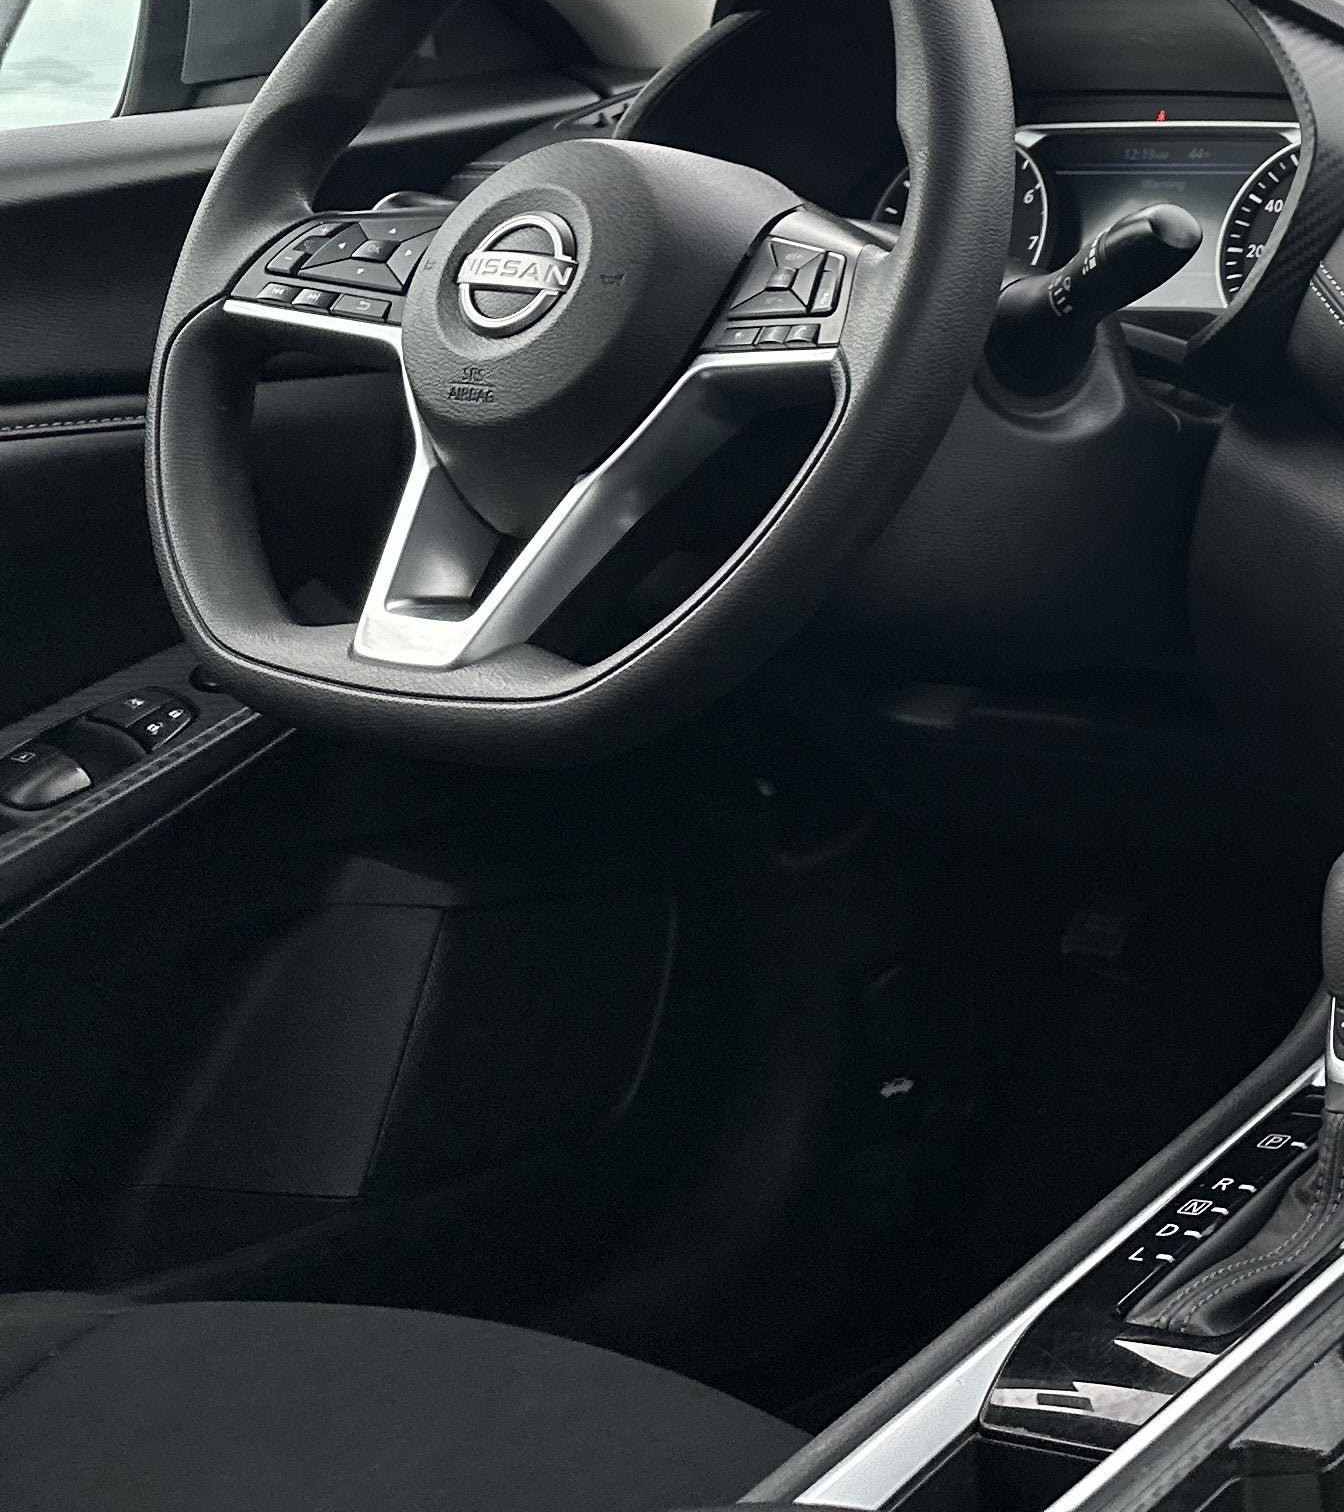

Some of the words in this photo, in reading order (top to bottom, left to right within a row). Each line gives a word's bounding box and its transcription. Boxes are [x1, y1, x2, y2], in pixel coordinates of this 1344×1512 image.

[1024, 189, 1035, 204] 6
[1265, 199, 1284, 213] 40
[1028, 235, 1040, 250] 7
[1246, 244, 1265, 258] 20
[463, 257, 573, 287] NISSAN
[1211, 1178, 1235, 1191] R
[1155, 1224, 1179, 1237] D
[1128, 1246, 1145, 1262] L
